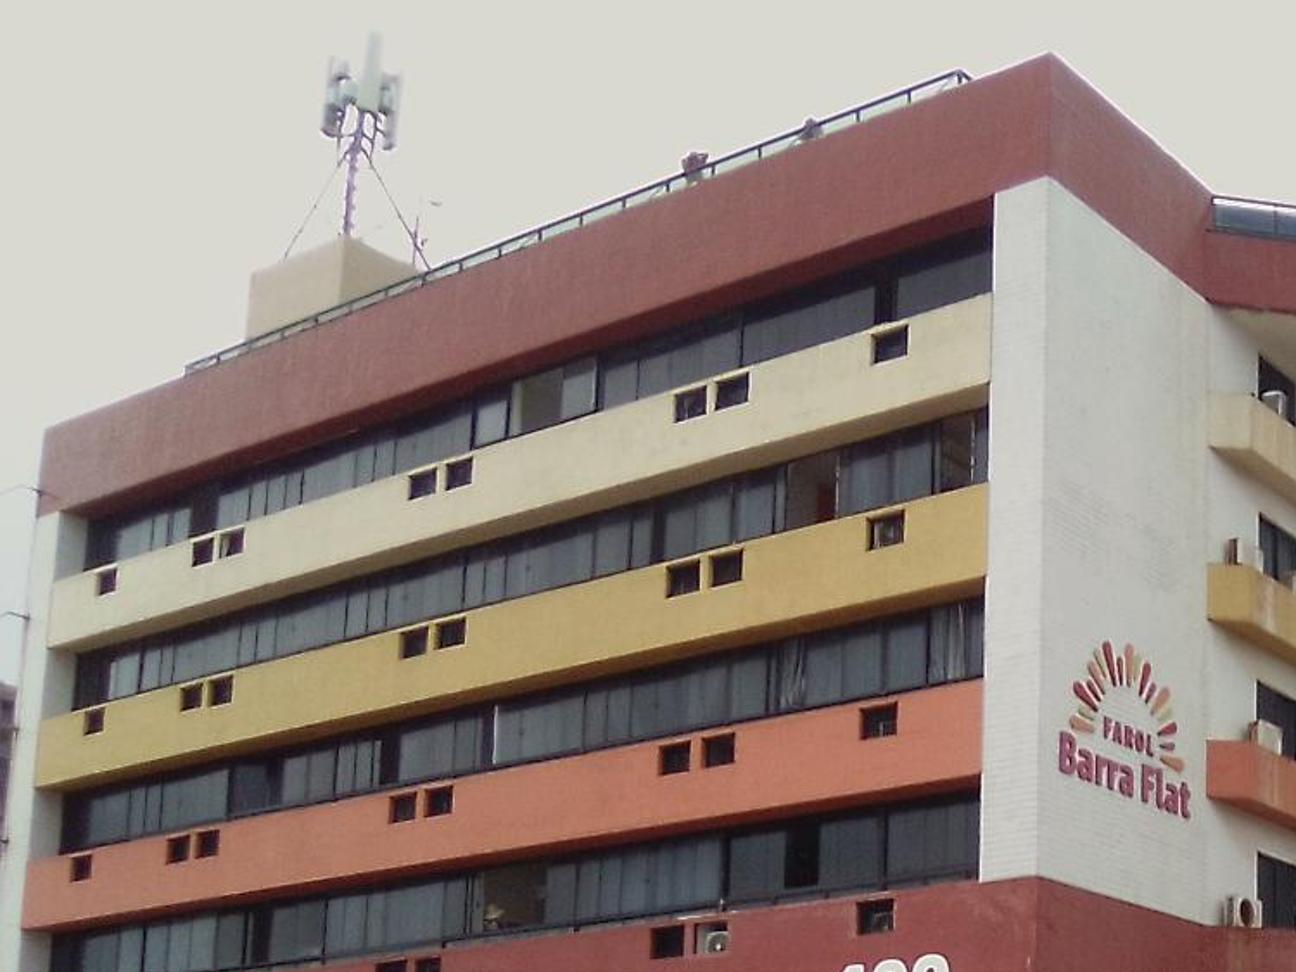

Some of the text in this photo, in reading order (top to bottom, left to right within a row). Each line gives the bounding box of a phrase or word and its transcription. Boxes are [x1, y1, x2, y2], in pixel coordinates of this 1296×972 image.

[1103, 715, 1154, 757] FAROL
[1058, 730, 1191, 820] Barra Flat
